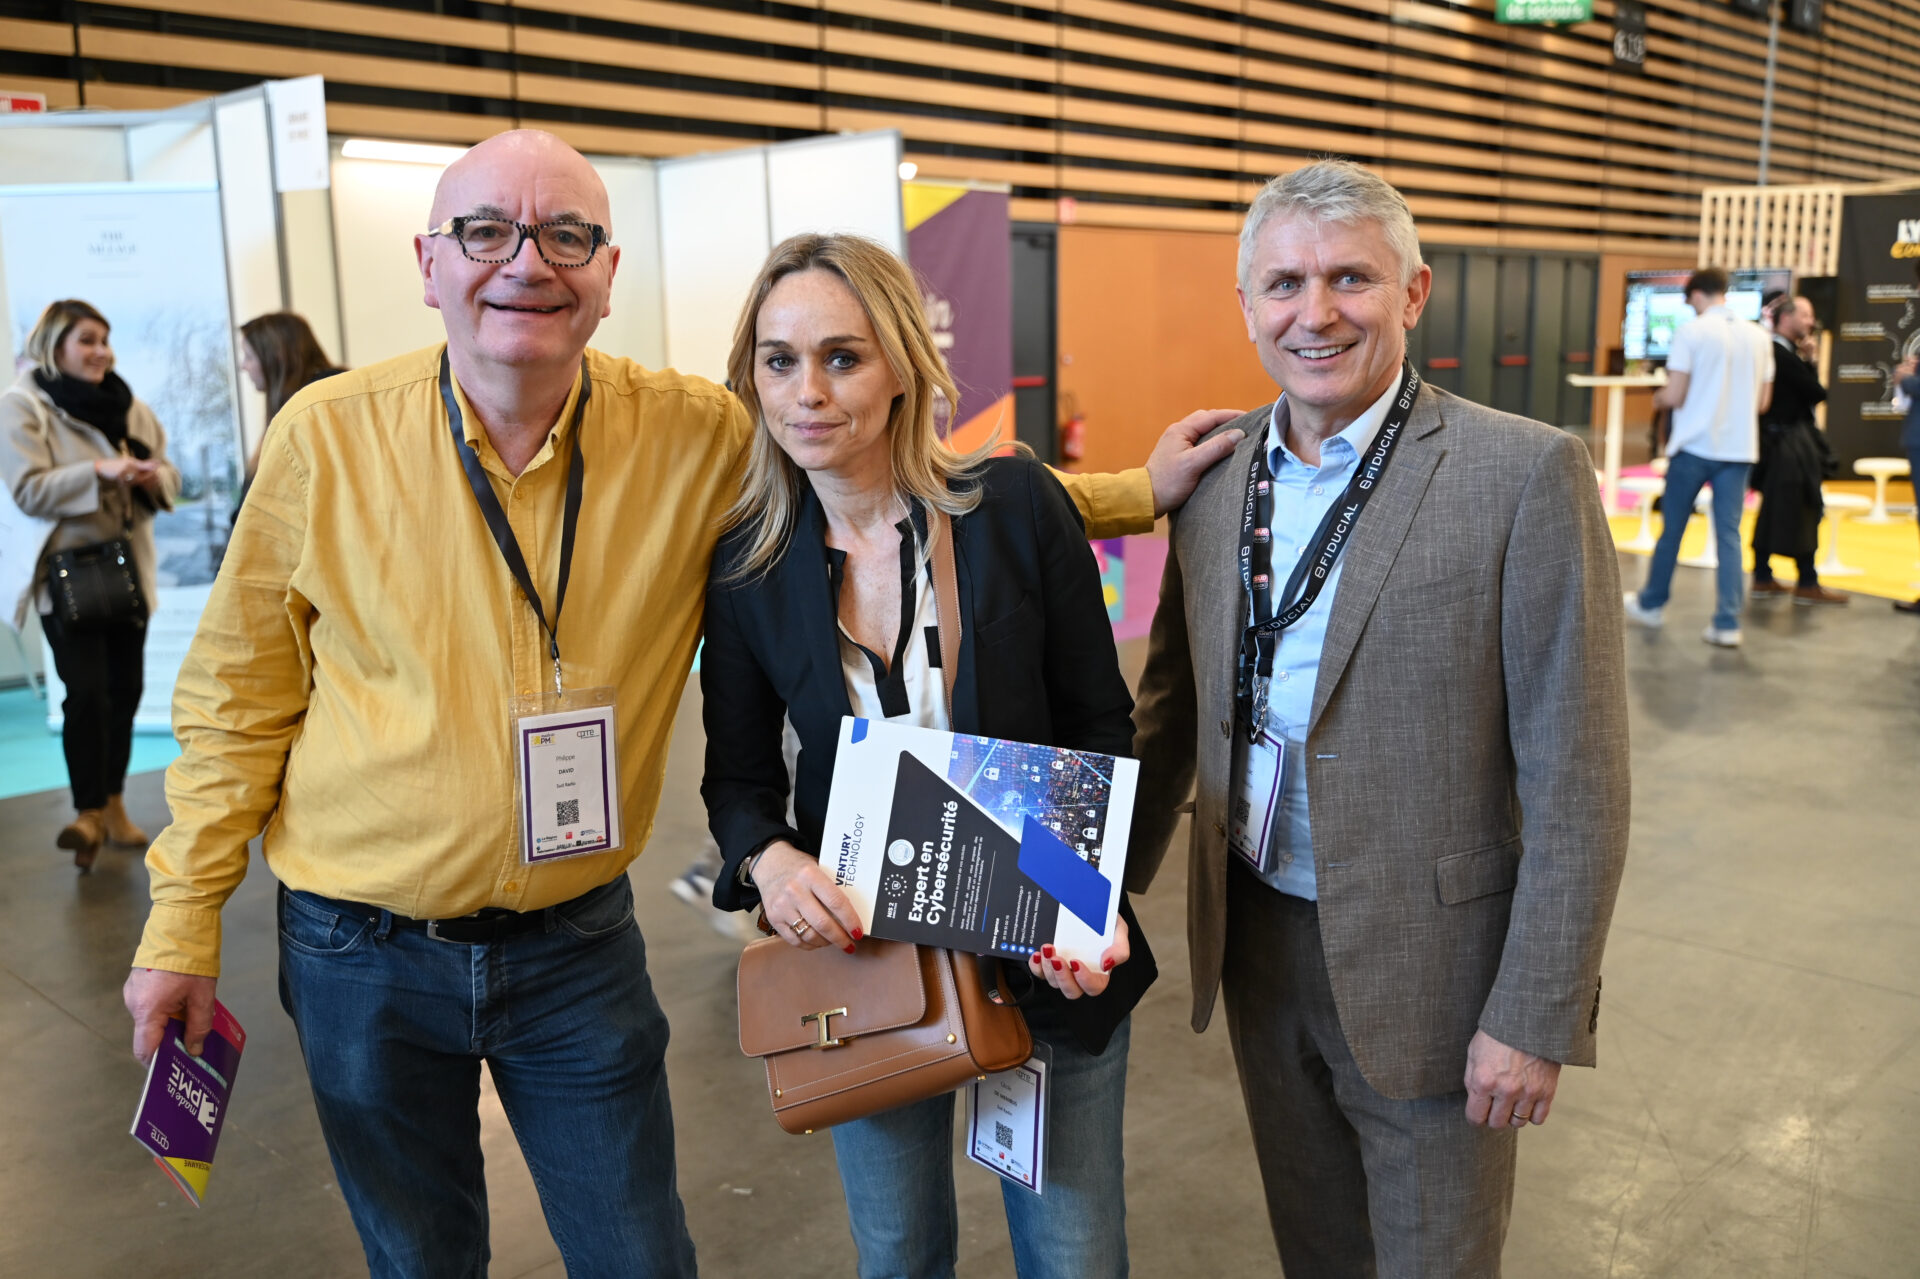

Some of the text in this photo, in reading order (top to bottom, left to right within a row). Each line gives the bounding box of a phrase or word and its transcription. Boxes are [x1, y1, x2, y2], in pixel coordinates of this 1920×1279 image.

[835, 833, 852, 886] VENTURY
[845, 813, 865, 887] TECHNOLOGY
[908, 841, 934, 922] Expert en
[926, 801, 958, 925] Cybersécurité
[167, 1083, 197, 1116] made in
[168, 1062, 203, 1109] PME
